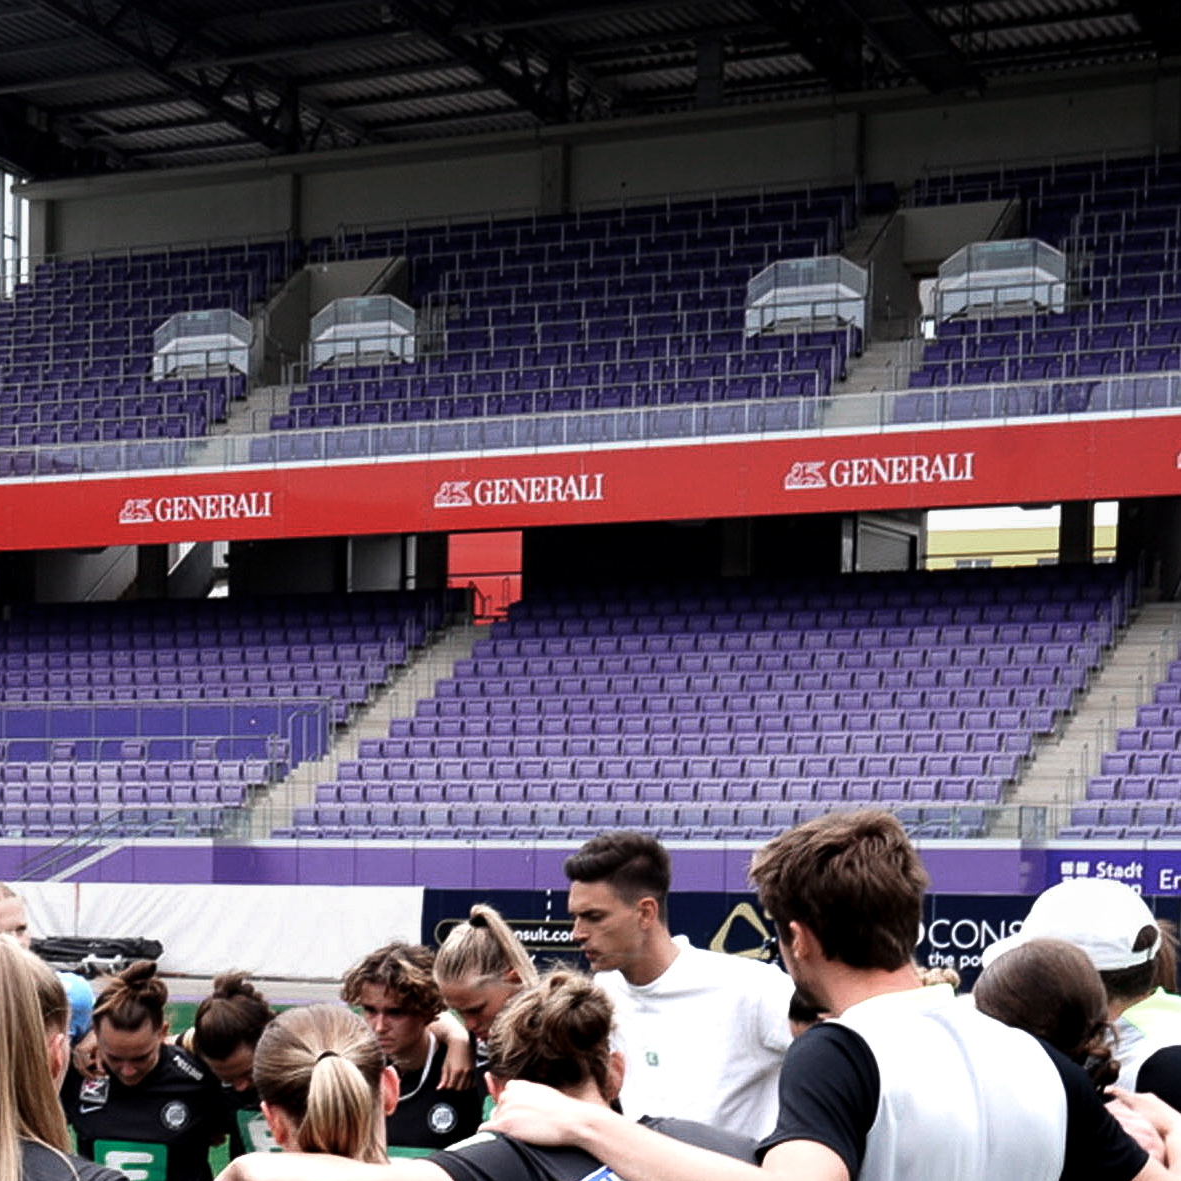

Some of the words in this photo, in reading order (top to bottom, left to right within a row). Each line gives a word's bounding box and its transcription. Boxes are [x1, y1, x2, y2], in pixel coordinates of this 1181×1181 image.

[829, 452, 975, 488] GENERALI
[473, 473, 604, 507] GENERALI
[155, 491, 272, 522] GENERALI
[1096, 861, 1143, 879] Stadt
[927, 952, 955, 969] the
